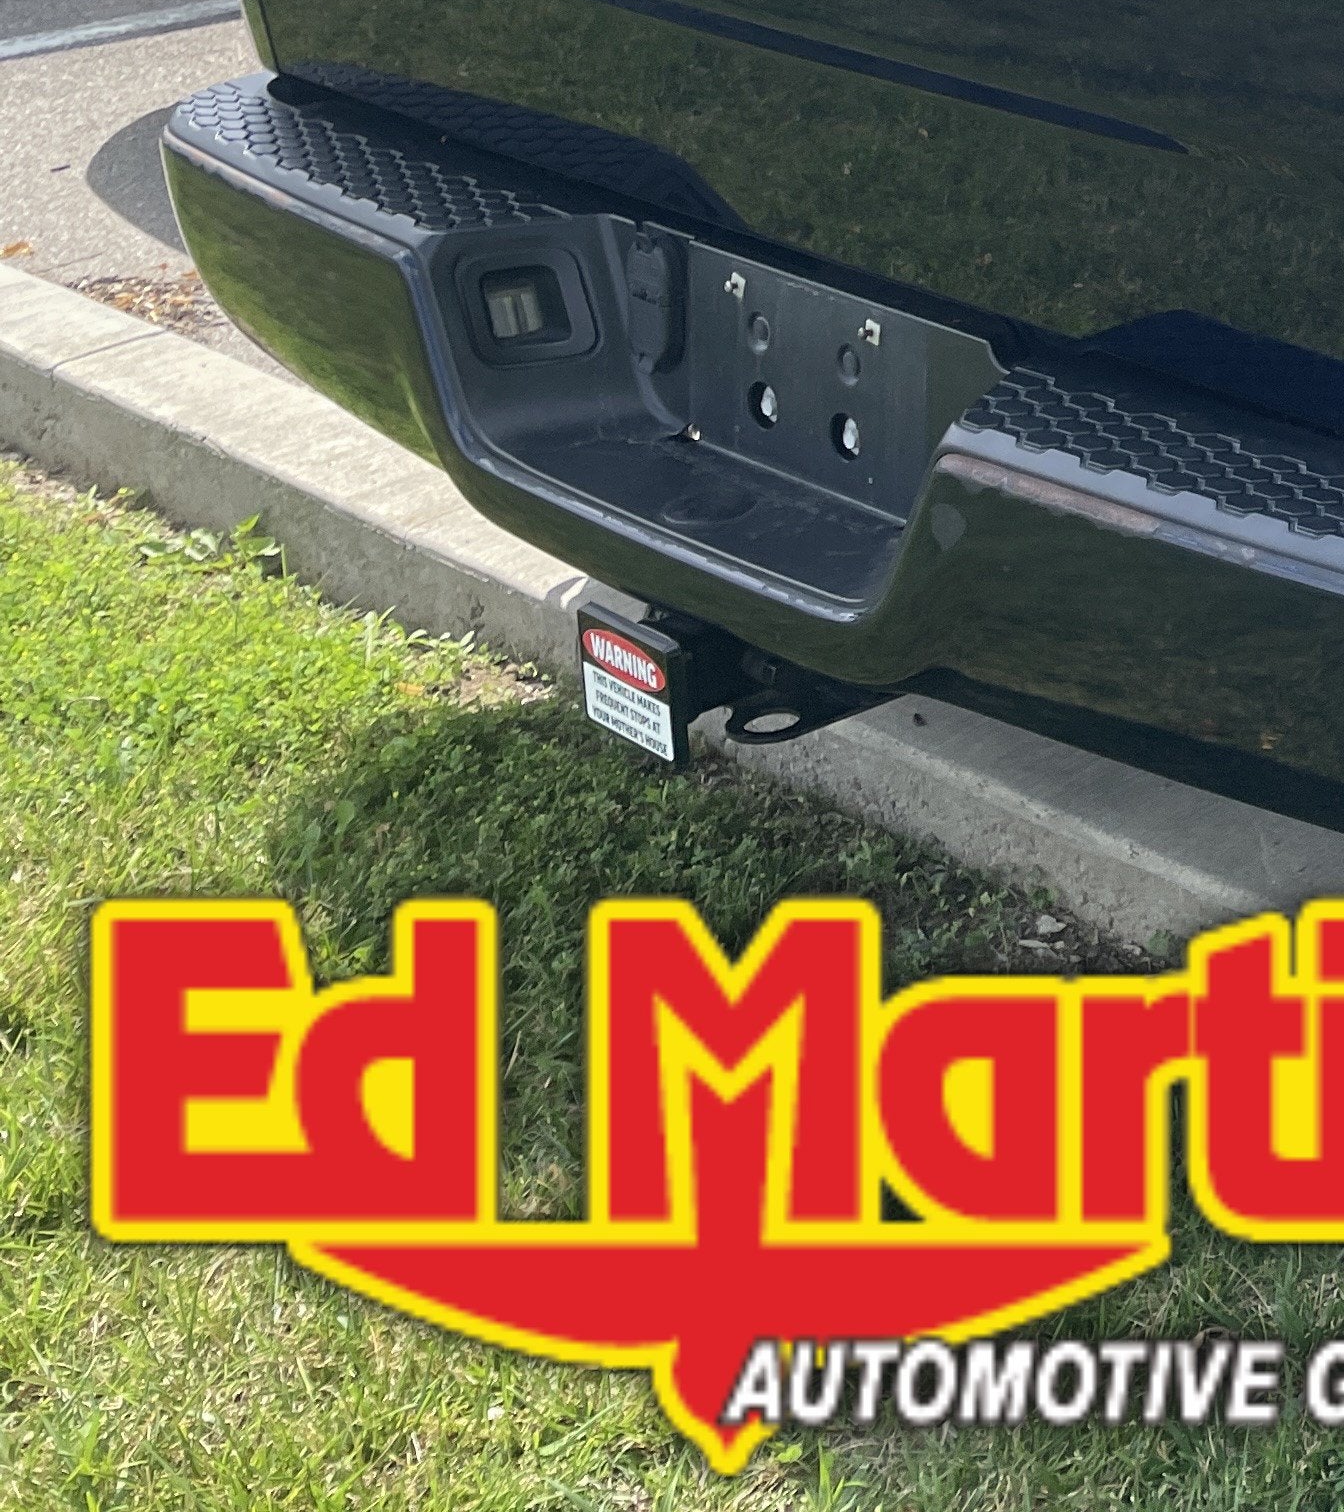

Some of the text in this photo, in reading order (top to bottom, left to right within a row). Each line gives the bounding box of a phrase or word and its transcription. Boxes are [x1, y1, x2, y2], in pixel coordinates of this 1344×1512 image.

[590, 633, 658, 689] WARNING
[593, 670, 660, 717] THIS VEHICLE MAKES
[595, 689, 661, 735] FREQUENT STOPS AT
[592, 705, 610, 724] YOUR
[645, 734, 668, 757] HOUSE
